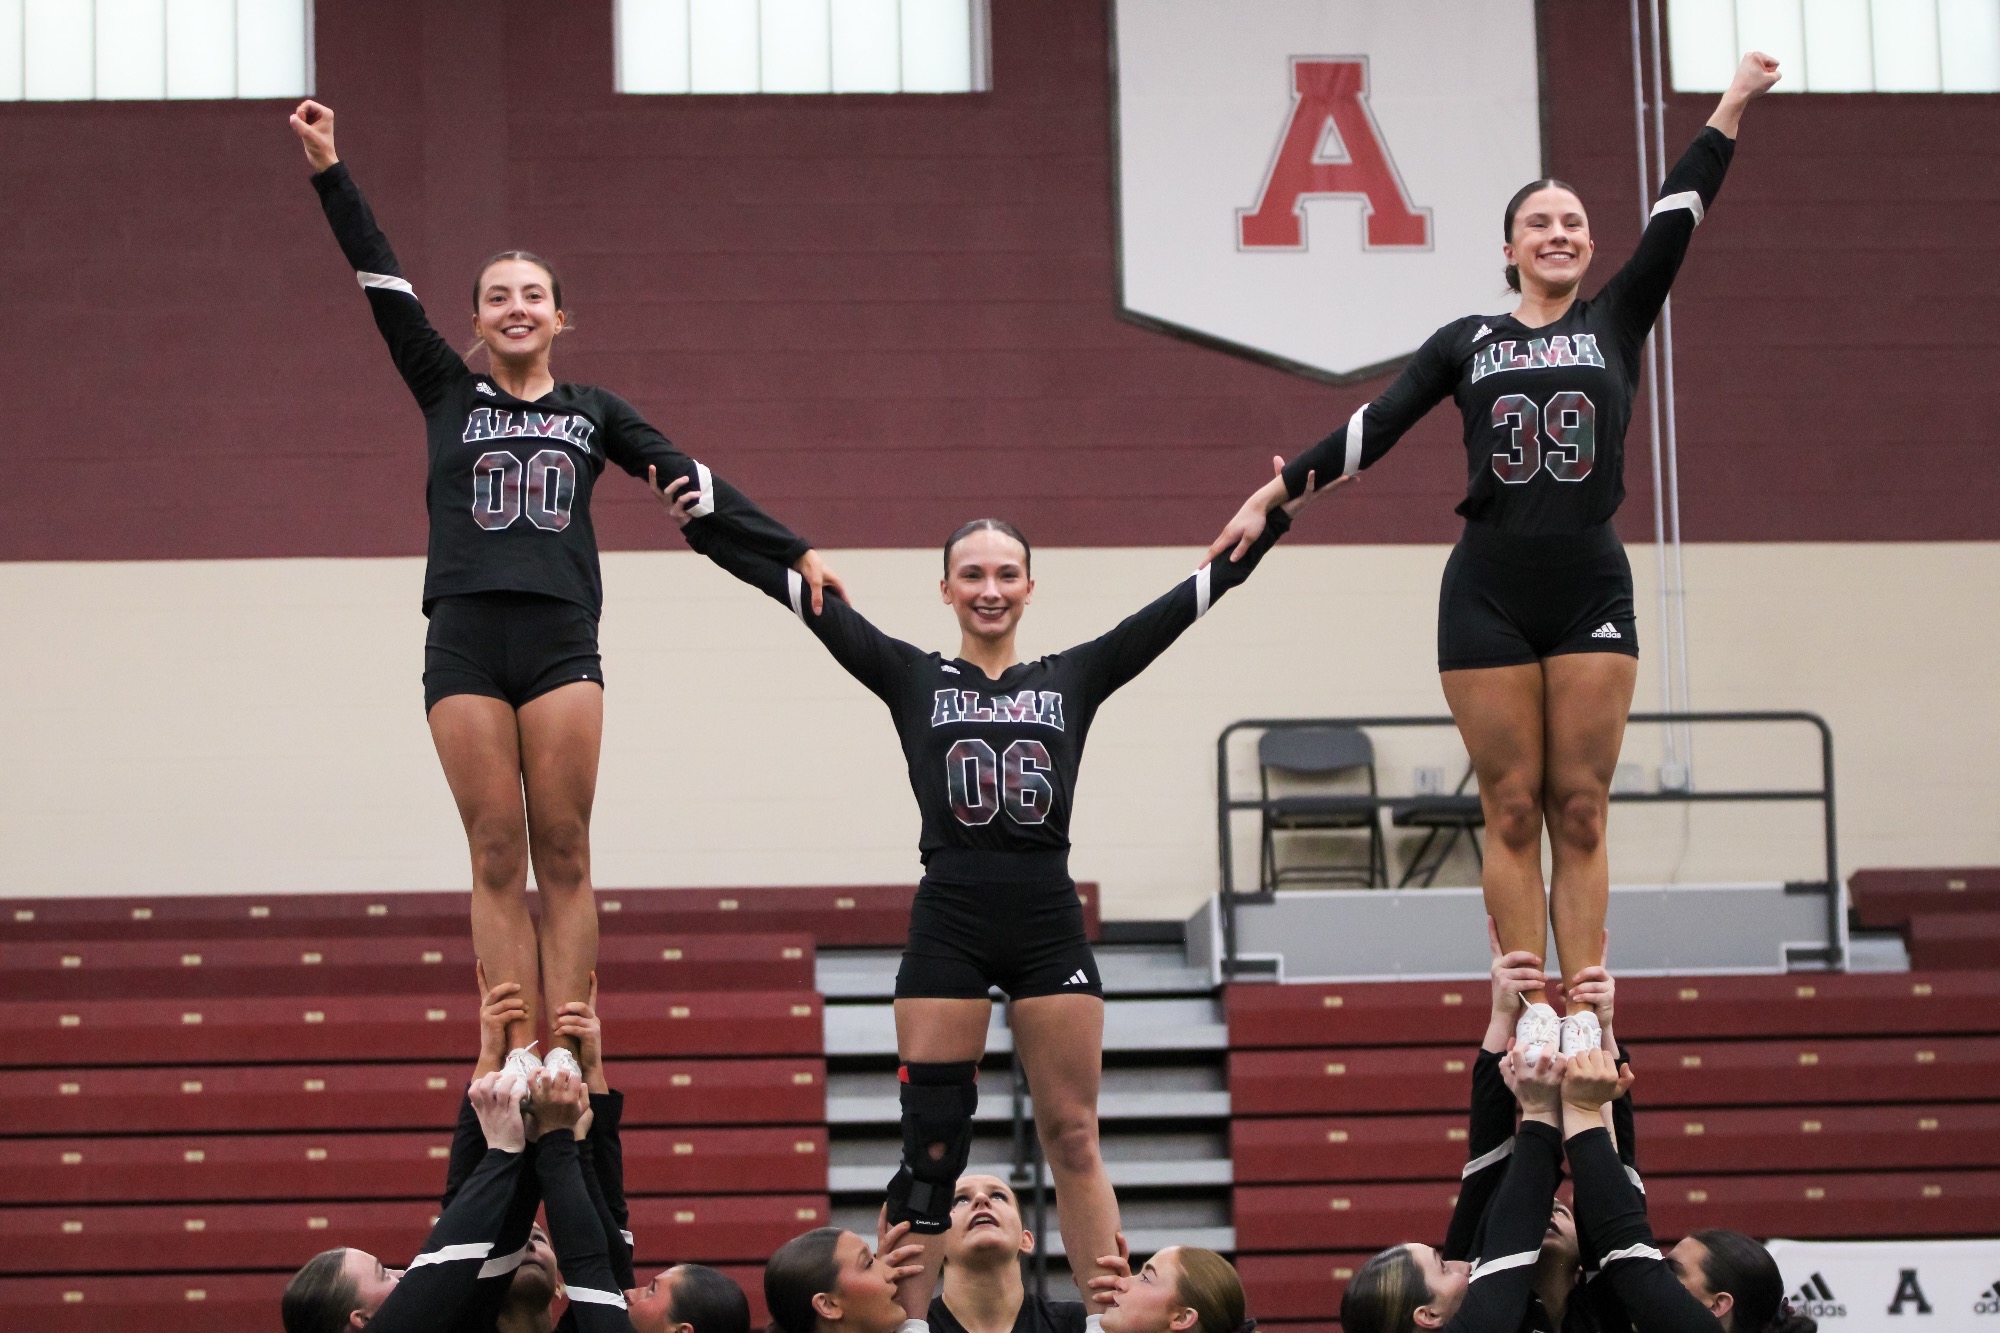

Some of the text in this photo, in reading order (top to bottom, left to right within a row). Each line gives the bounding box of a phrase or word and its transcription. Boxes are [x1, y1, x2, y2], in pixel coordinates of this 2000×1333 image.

[1235, 54, 1435, 252] A
[1472, 334, 1605, 384] ALMA
[463, 408, 595, 453] ALMA
[1491, 391, 1595, 483] 39
[472, 449, 575, 532] 00
[931, 688, 1064, 732] ALMA
[946, 739, 1052, 826] 06
[1796, 1300, 1848, 1318] didas
[1887, 1268, 1932, 1315] A
